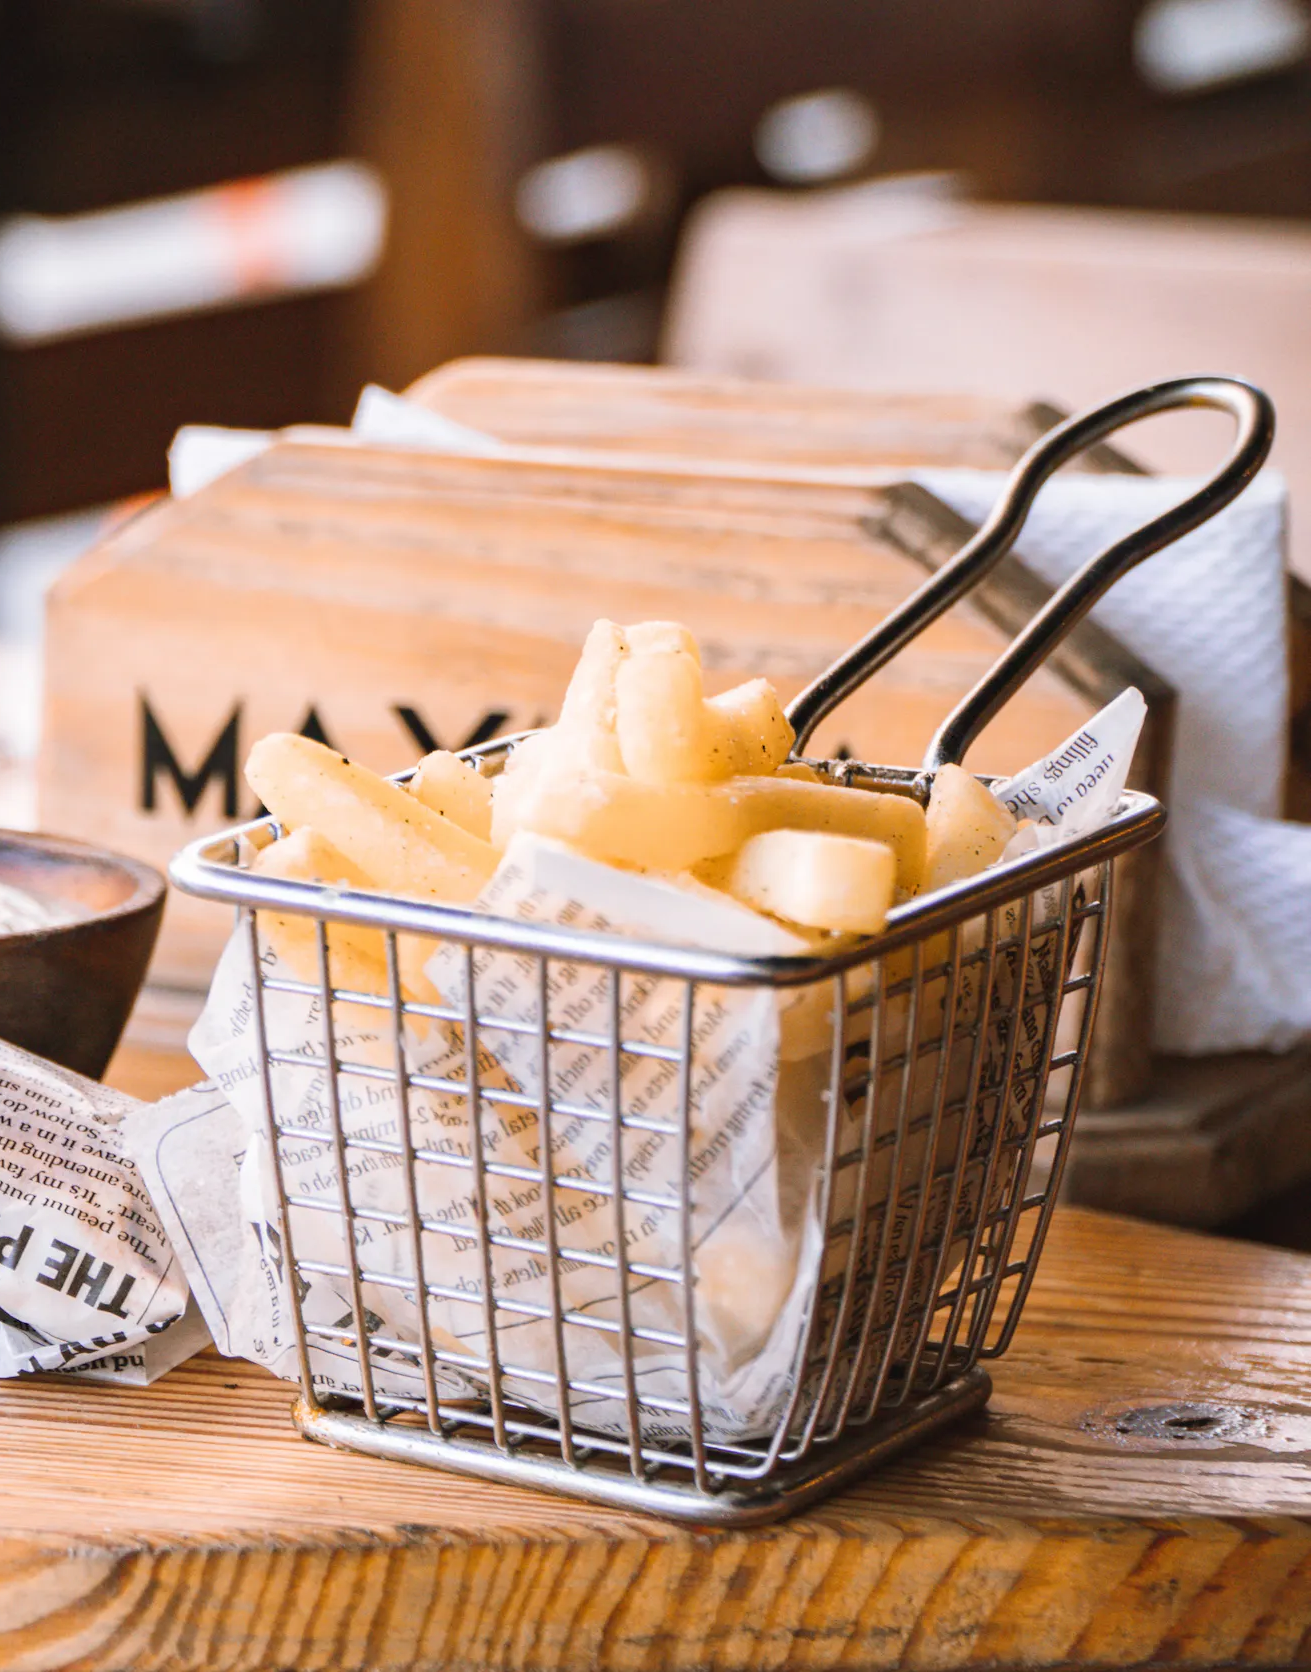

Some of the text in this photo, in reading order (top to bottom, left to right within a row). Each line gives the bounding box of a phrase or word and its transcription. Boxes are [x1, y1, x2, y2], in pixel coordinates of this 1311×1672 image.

[1043, 731, 1099, 784] fillings
[2, 1098, 29, 1113] do
[18, 1121, 32, 1133] a
[29, 1108, 75, 1131] how
[36, 1127, 58, 1145] in
[75, 1124, 101, 1140] So
[60, 1136, 77, 1151] it
[18, 1141, 120, 1186] amending
[28, 1170, 65, 1190] my
[42, 1197, 116, 1234] peanut
[35, 1238, 137, 1320] THE
